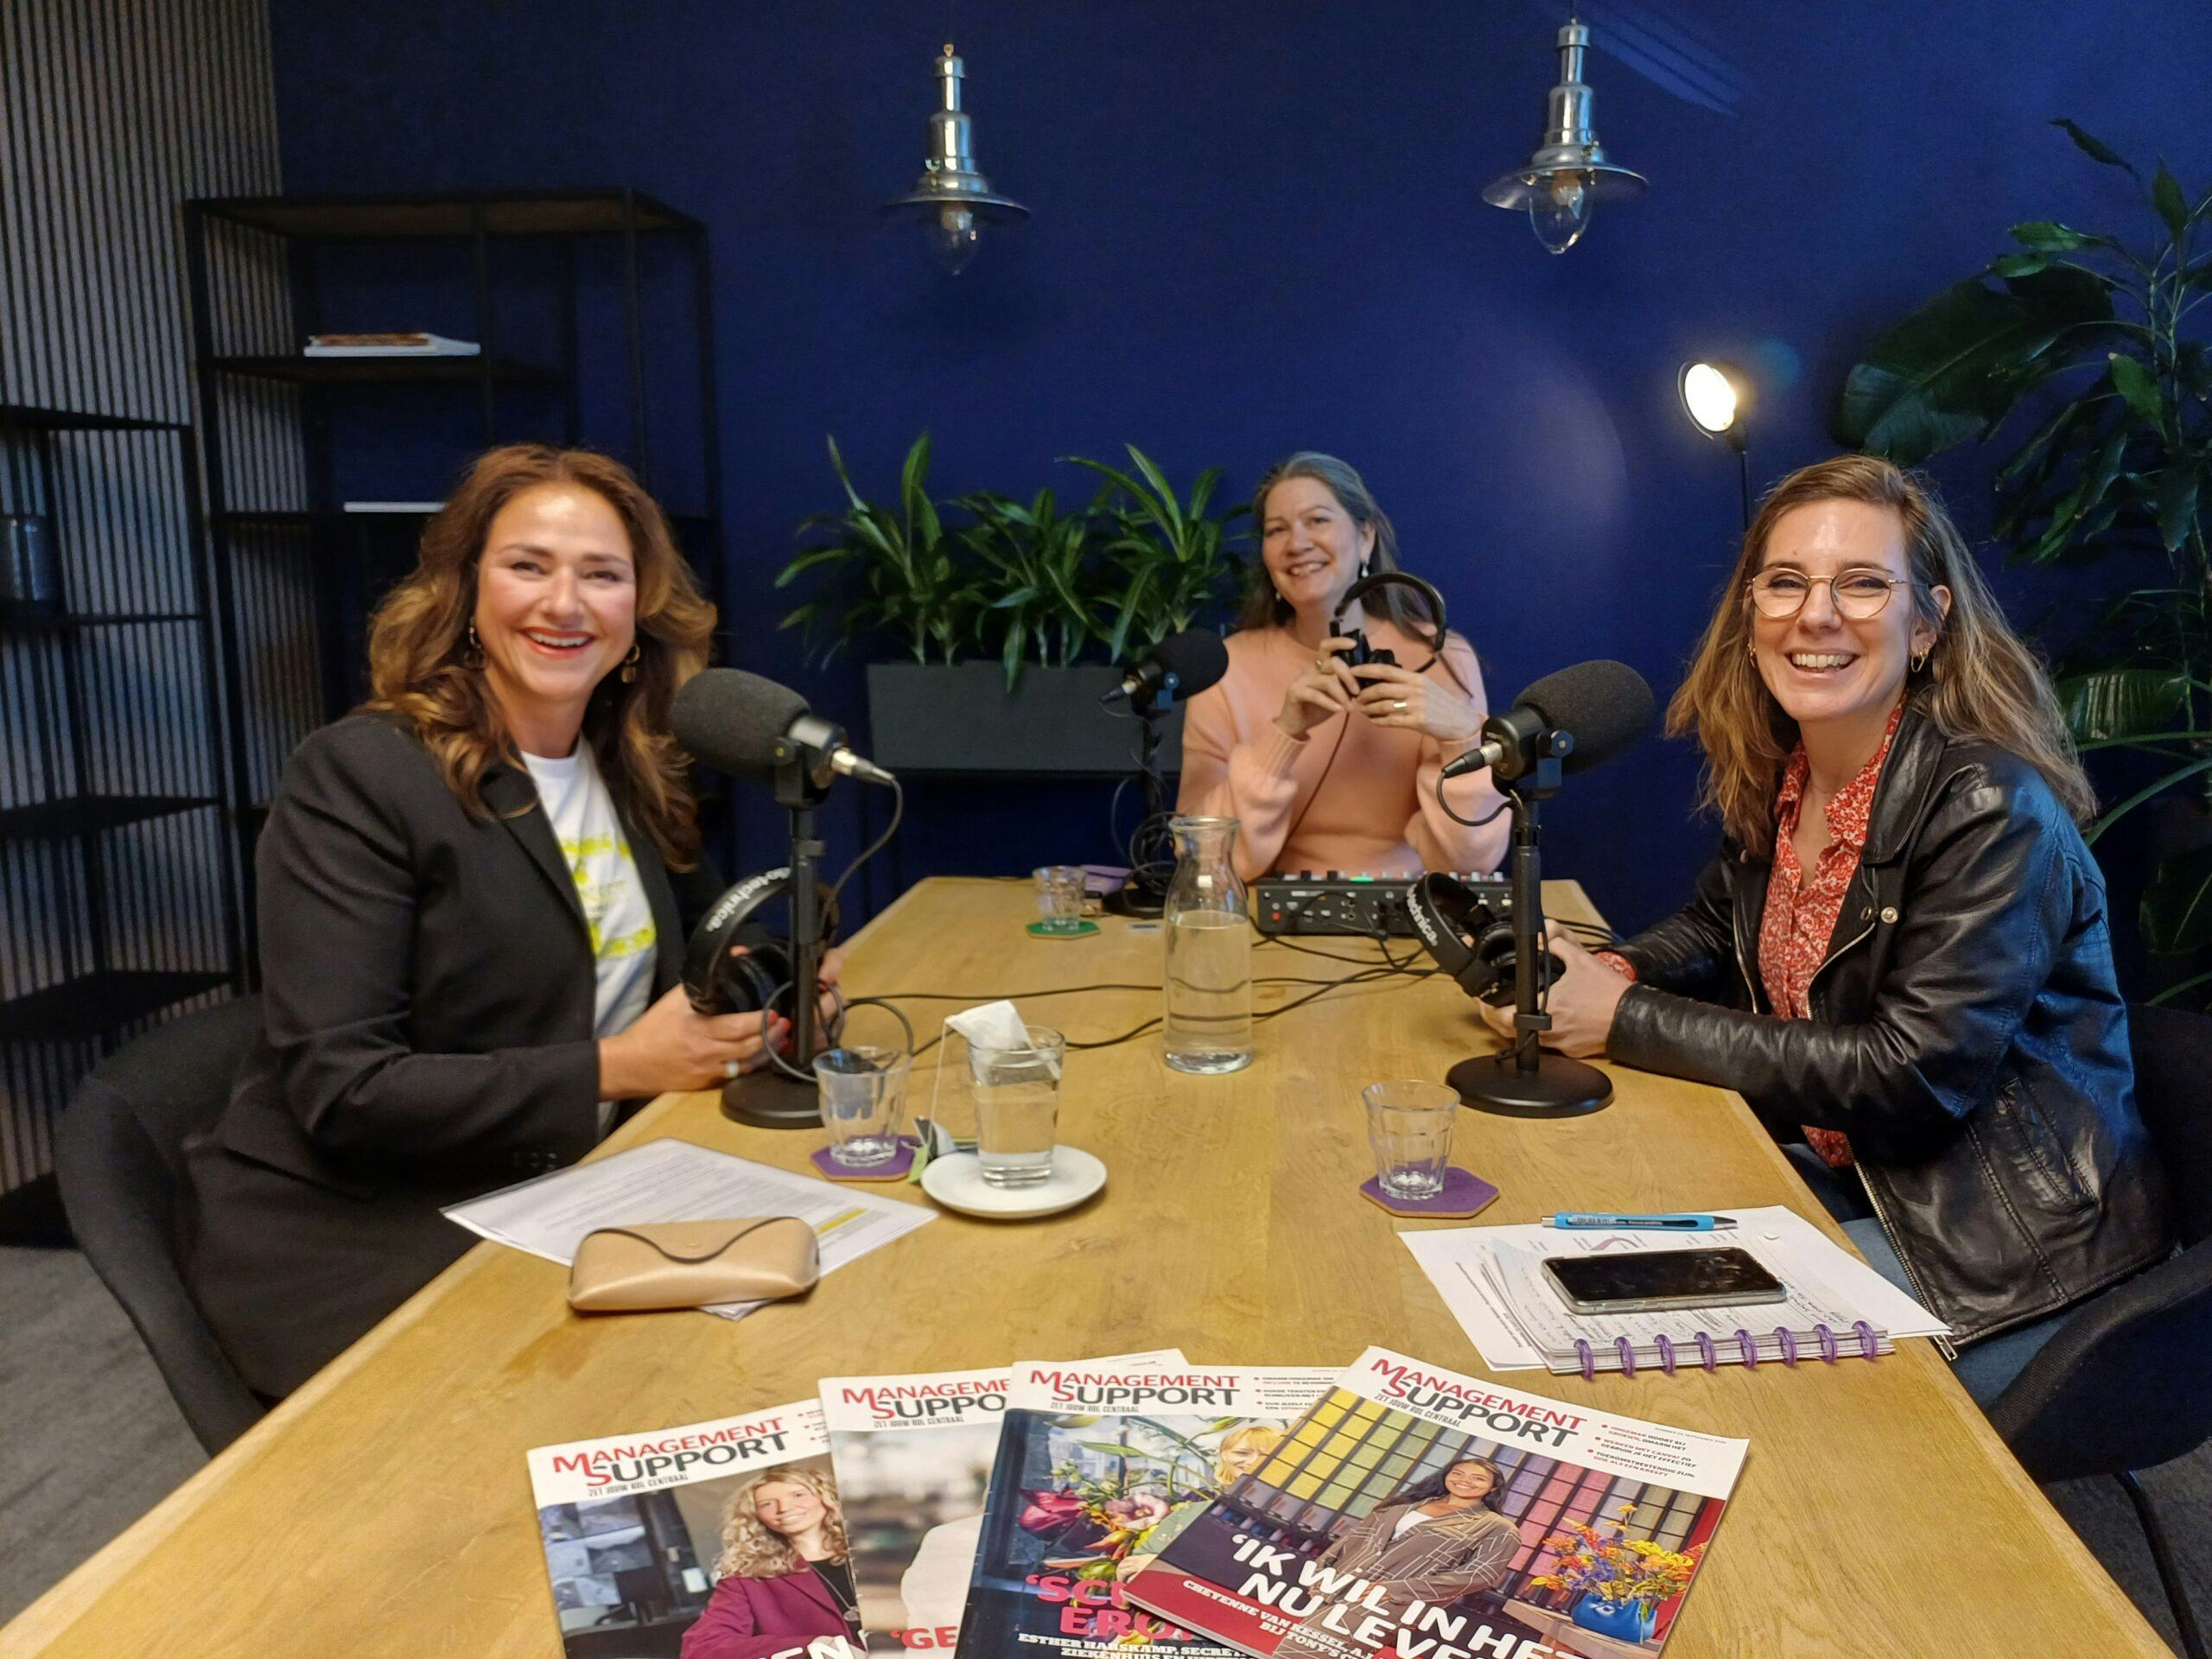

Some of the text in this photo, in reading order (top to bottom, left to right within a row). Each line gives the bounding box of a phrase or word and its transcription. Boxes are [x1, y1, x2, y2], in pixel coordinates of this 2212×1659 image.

[1030, 1370, 1240, 1388] MANAGEMENT
[1051, 1384, 1241, 1405] SUPPORT
[1370, 1358, 1587, 1430] MANAGEMENT
[1374, 1393, 1462, 1427] ZET JOUW ROL CENTRAAL
[1381, 1381, 1580, 1447] SUPPORT
[553, 1417, 783, 1472] MANAGEMENT
[586, 1431, 790, 1487] SUPPORT
[1183, 1580, 1259, 1617] CHEYENNE
[1259, 1611, 1292, 1630] VAN
[1237, 1573, 1324, 1617] NU
[1299, 1560, 1389, 1616] WIL
[1400, 1600, 1467, 1642] IN
[1468, 1625, 1585, 1659] HE
[1018, 1633, 1082, 1649] ESTHER
[1060, 1606, 1193, 1641] ERO
[1259, 1622, 1287, 1636] BIJ
